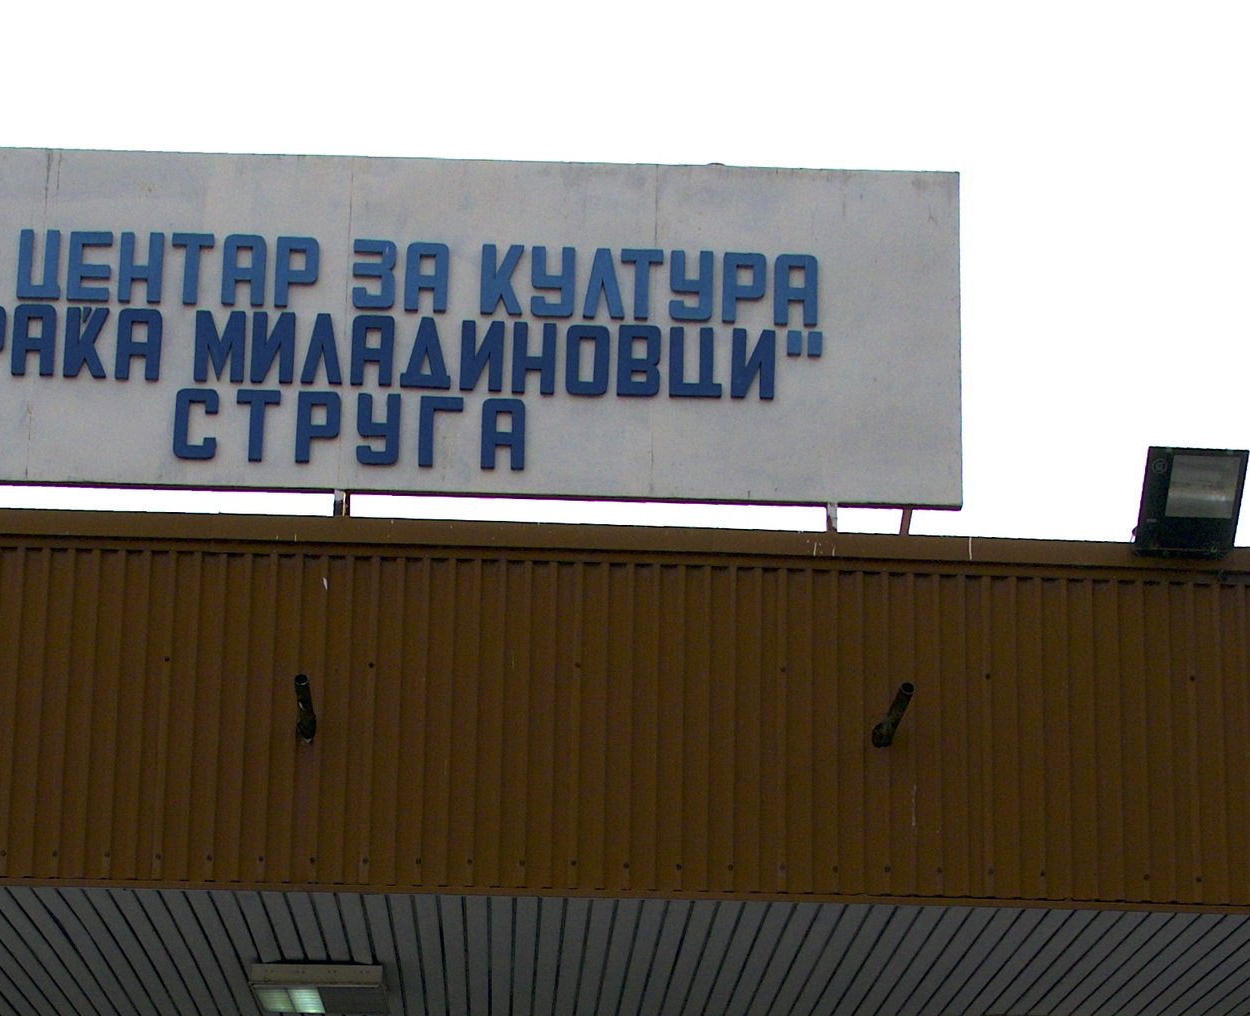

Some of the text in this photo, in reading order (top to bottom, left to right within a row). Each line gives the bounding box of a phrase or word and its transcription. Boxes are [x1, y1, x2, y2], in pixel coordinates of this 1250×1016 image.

[15, 228, 321, 309] ЦЕНТАР
[350, 238, 451, 313] ЗА
[479, 243, 820, 327] КУЛТУРА
[172, 387, 526, 471] СТРУГА
